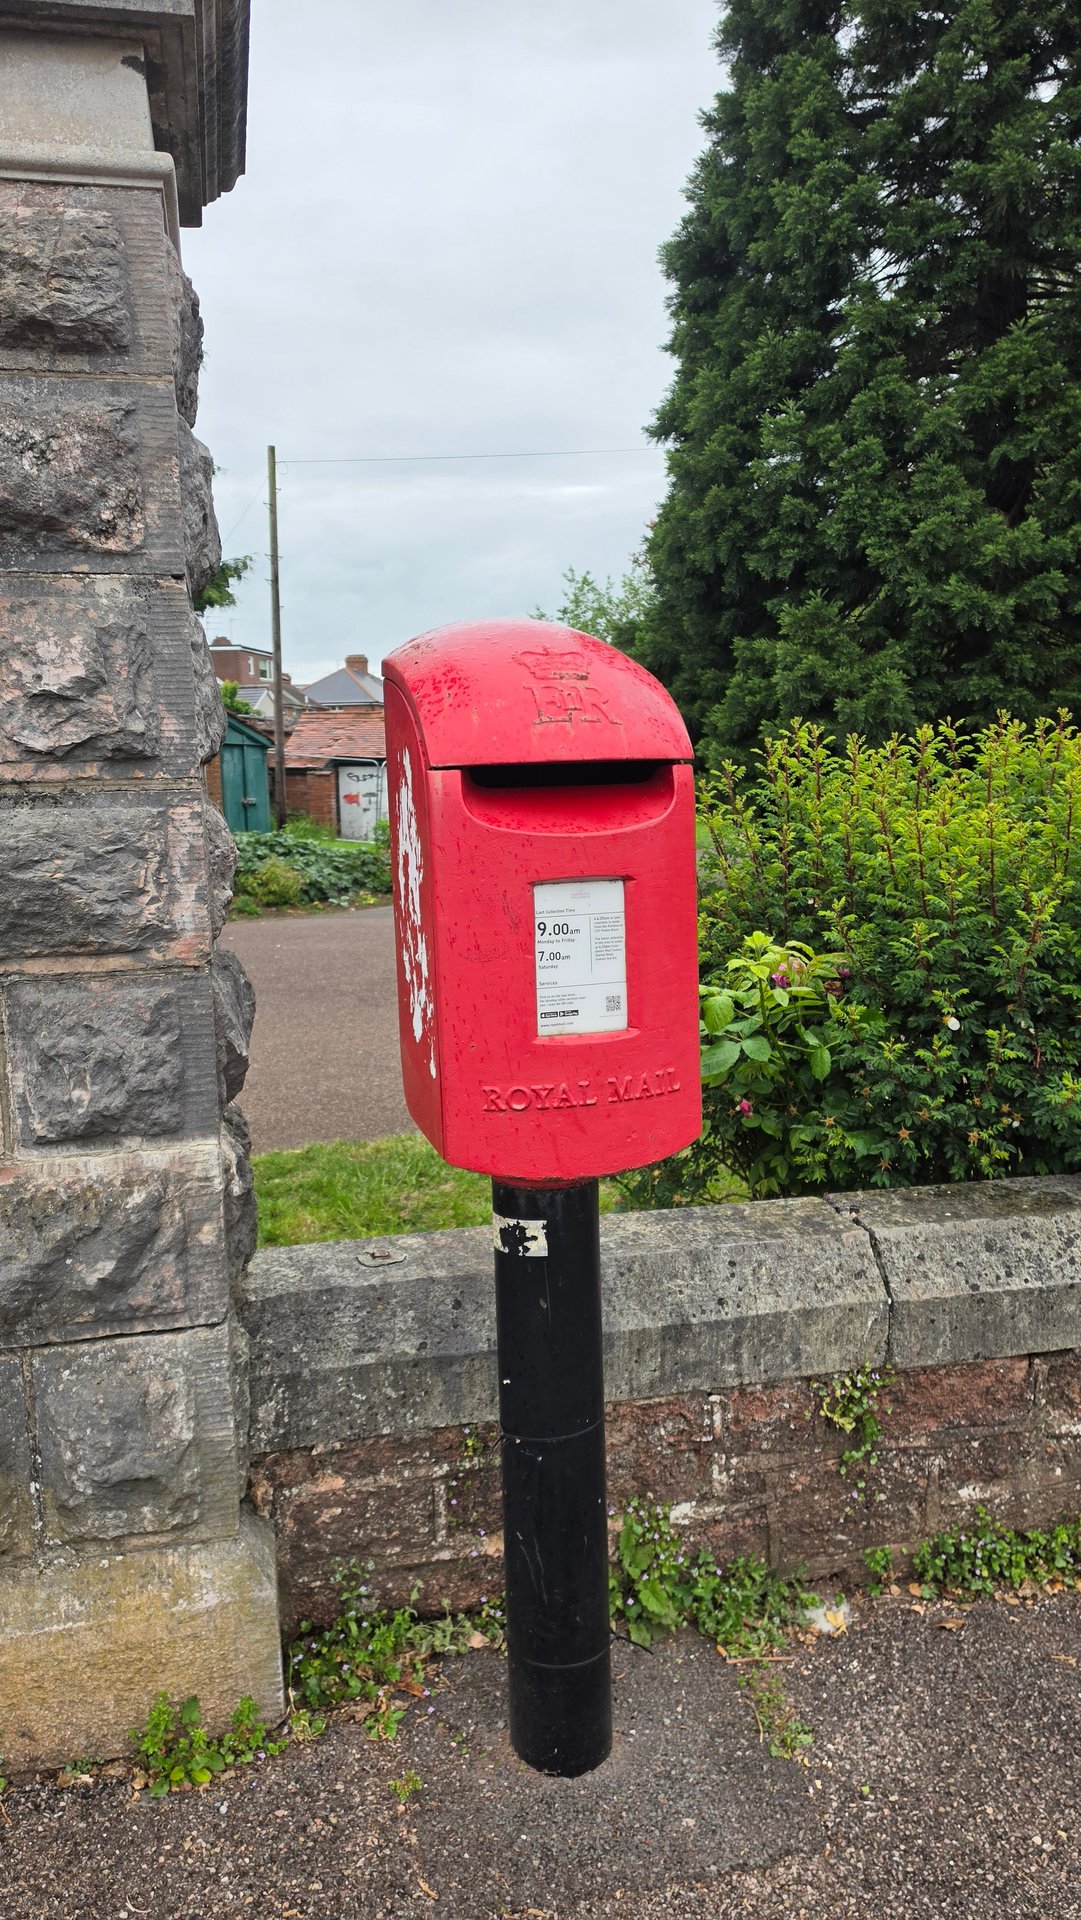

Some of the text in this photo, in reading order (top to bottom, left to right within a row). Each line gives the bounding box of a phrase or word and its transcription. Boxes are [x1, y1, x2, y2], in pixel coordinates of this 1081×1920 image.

[537, 921, 581, 937] 9.00am
[538, 951, 571, 962] 7.00am
[482, 1067, 681, 1112] ROYAL MAIL
